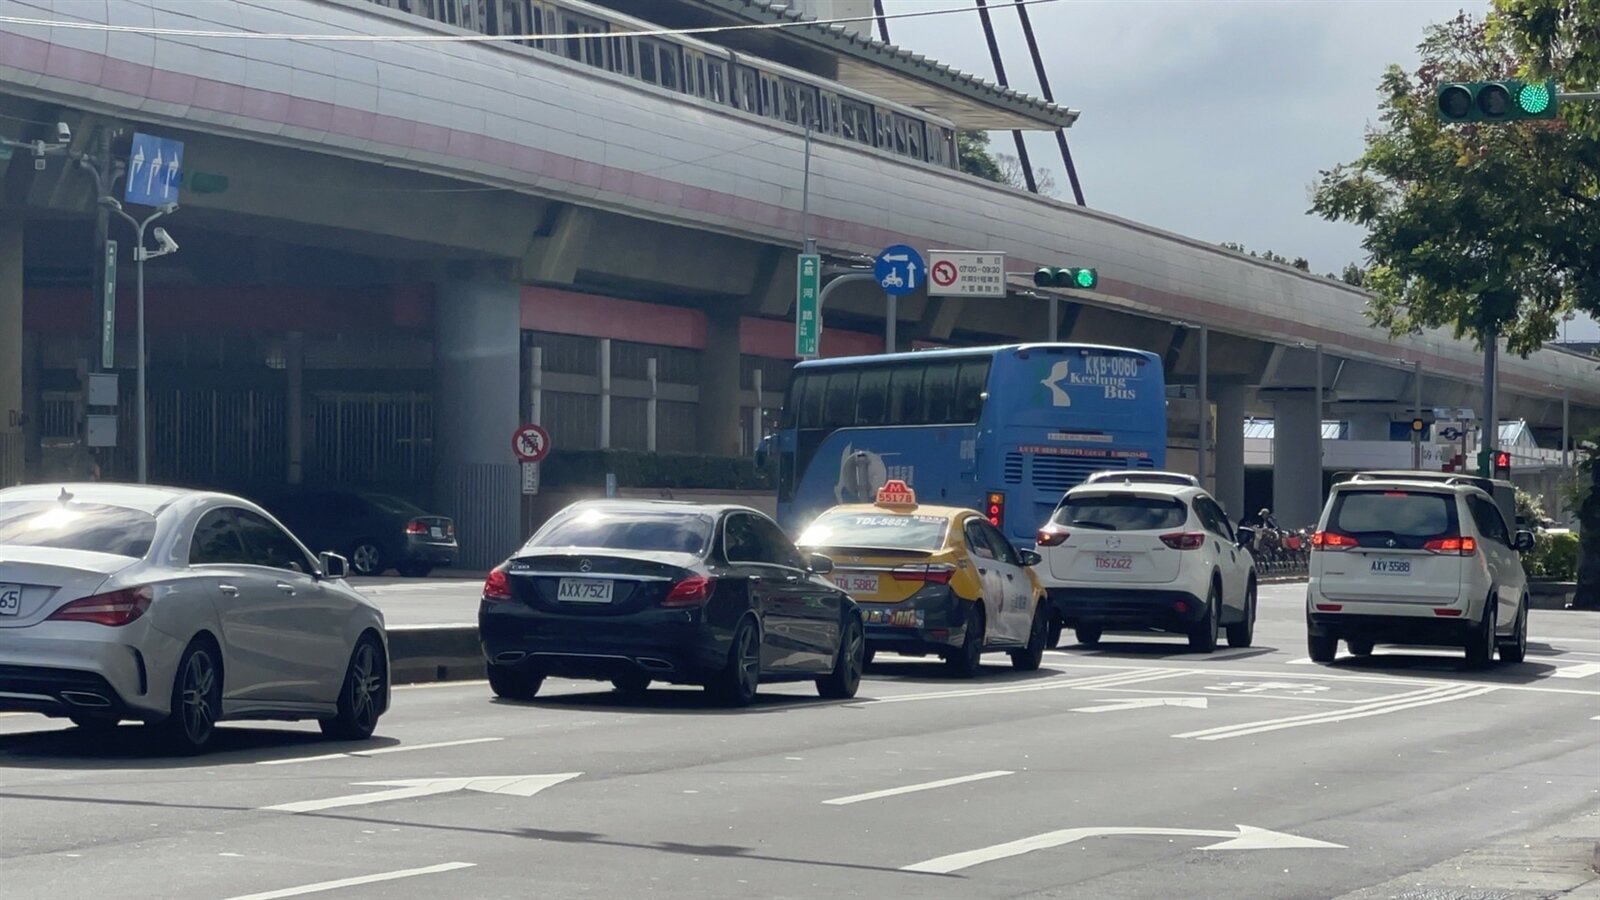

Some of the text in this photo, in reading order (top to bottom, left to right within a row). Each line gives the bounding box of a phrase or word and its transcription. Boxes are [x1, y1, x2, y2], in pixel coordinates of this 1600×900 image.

[1085, 356, 1137, 377] KKB-0060
[1070, 372, 1126, 388] Keelung
[1104, 385, 1136, 399] Bus
[879, 493, 912, 503] 55178
[560, 585, 610, 599] AXX-7521
